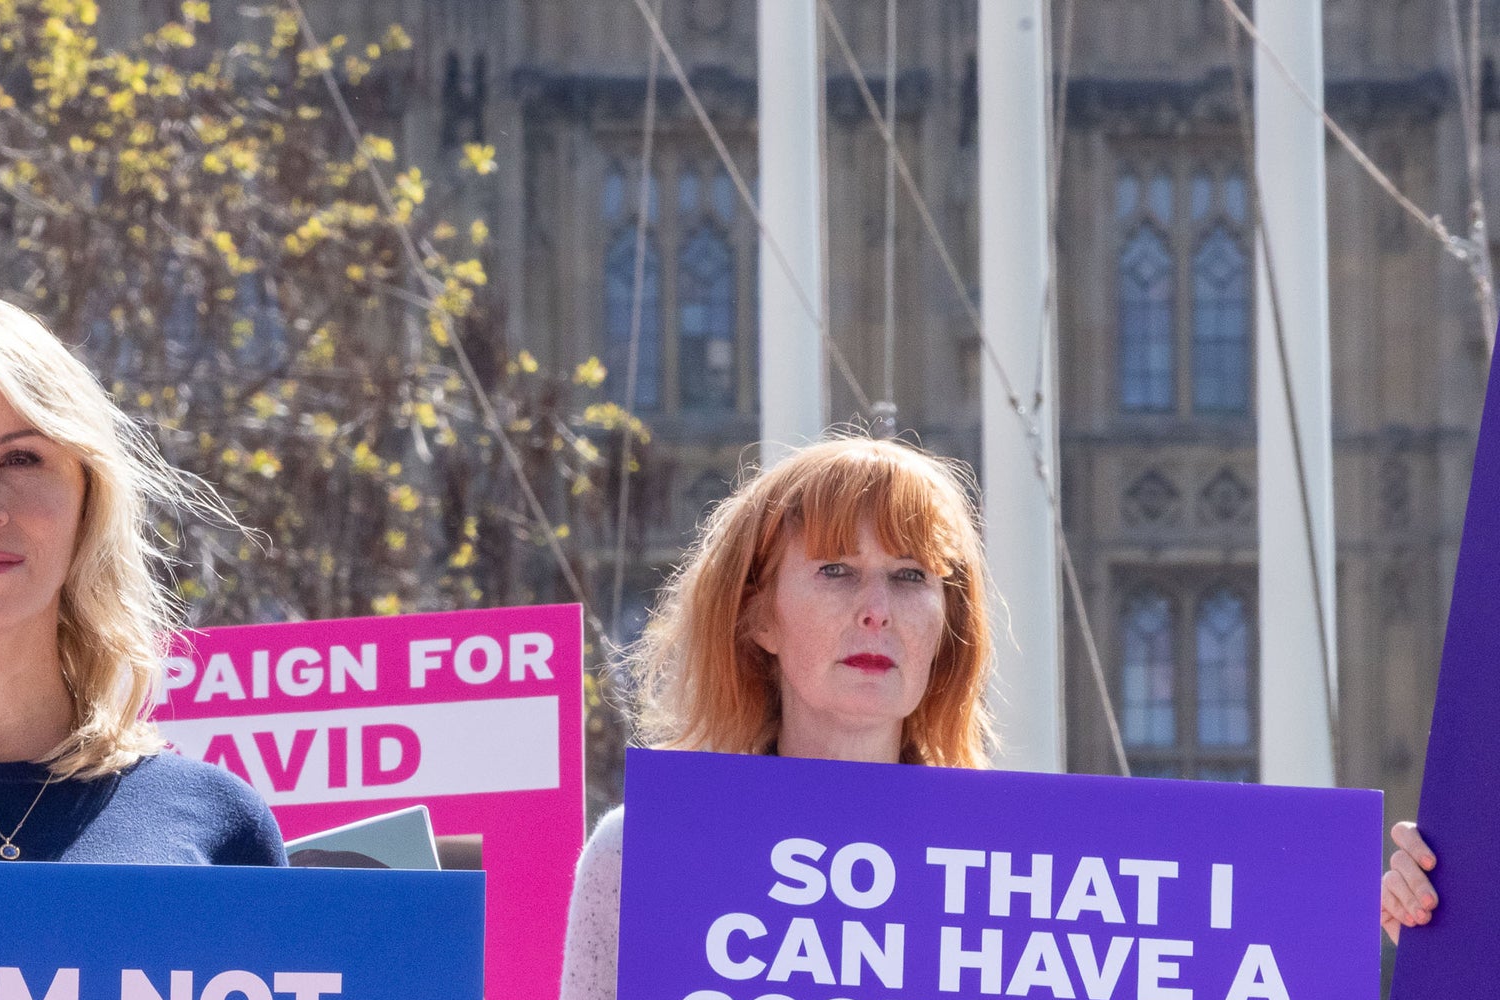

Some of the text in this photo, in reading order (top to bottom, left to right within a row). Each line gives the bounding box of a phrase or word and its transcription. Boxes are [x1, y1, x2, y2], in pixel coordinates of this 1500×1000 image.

[154, 632, 555, 704] PAIGN FOR
[200, 724, 422, 792] AVID
[767, 837, 1234, 929] SO THAT I
[706, 912, 906, 989] CAN
